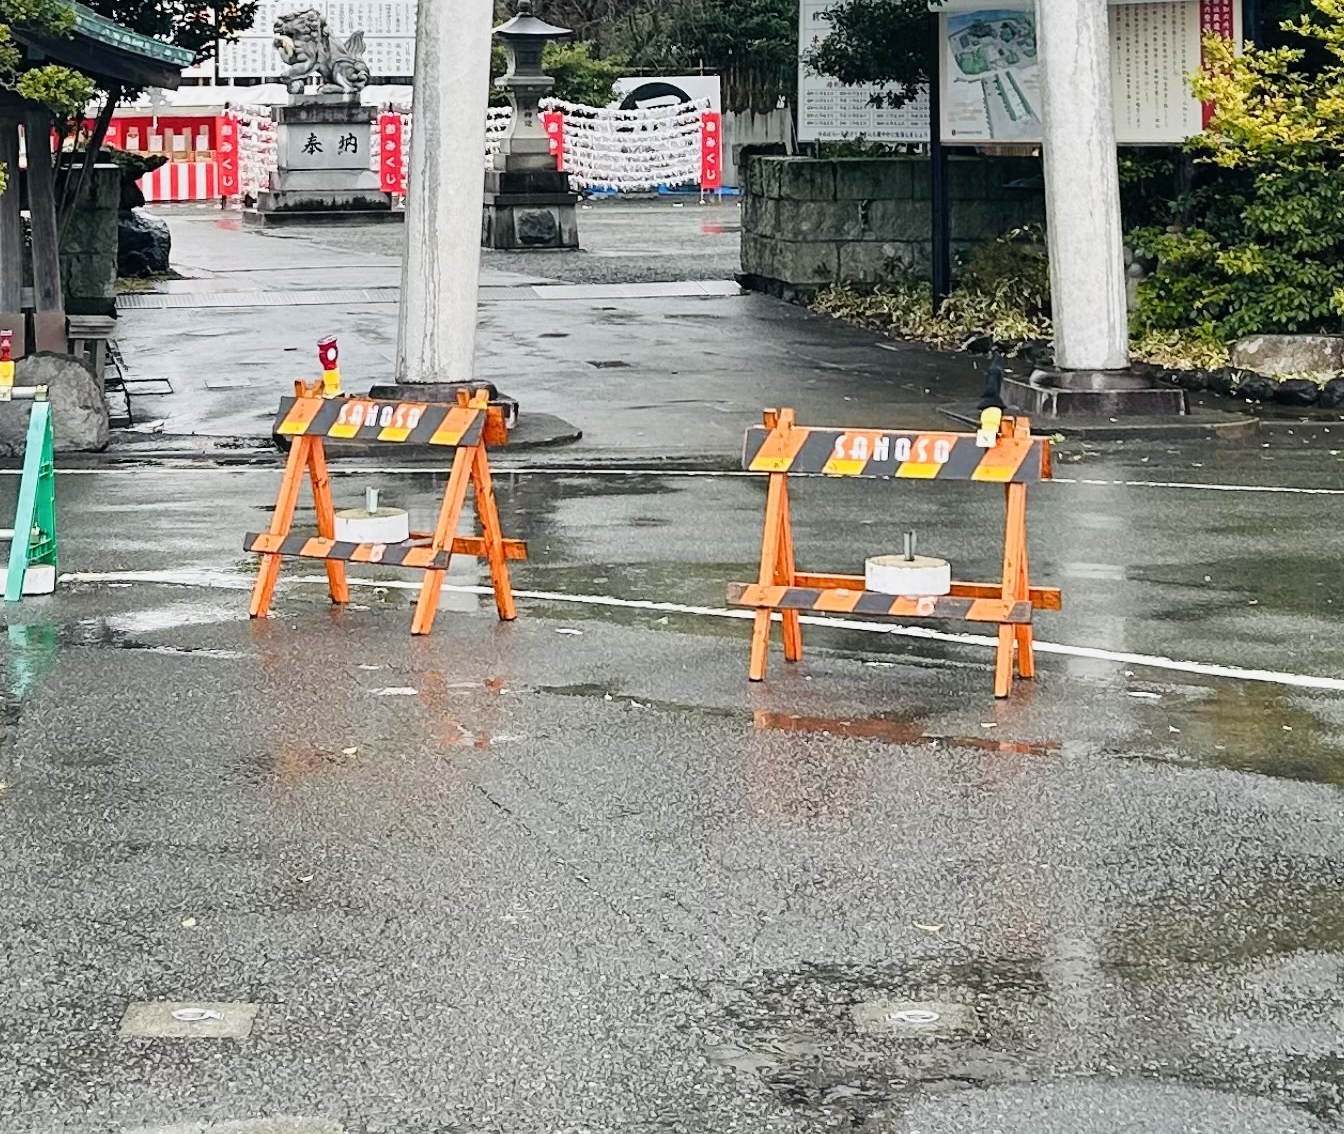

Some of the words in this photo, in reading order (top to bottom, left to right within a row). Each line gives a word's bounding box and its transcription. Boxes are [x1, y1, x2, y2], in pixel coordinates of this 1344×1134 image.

[220, 125, 234, 187] おみくじ
[301, 132, 358, 155] 奉納
[385, 124, 396, 185] おみくじ
[706, 121, 716, 180] おみくじ
[834, 435, 950, 464] SANOSO
